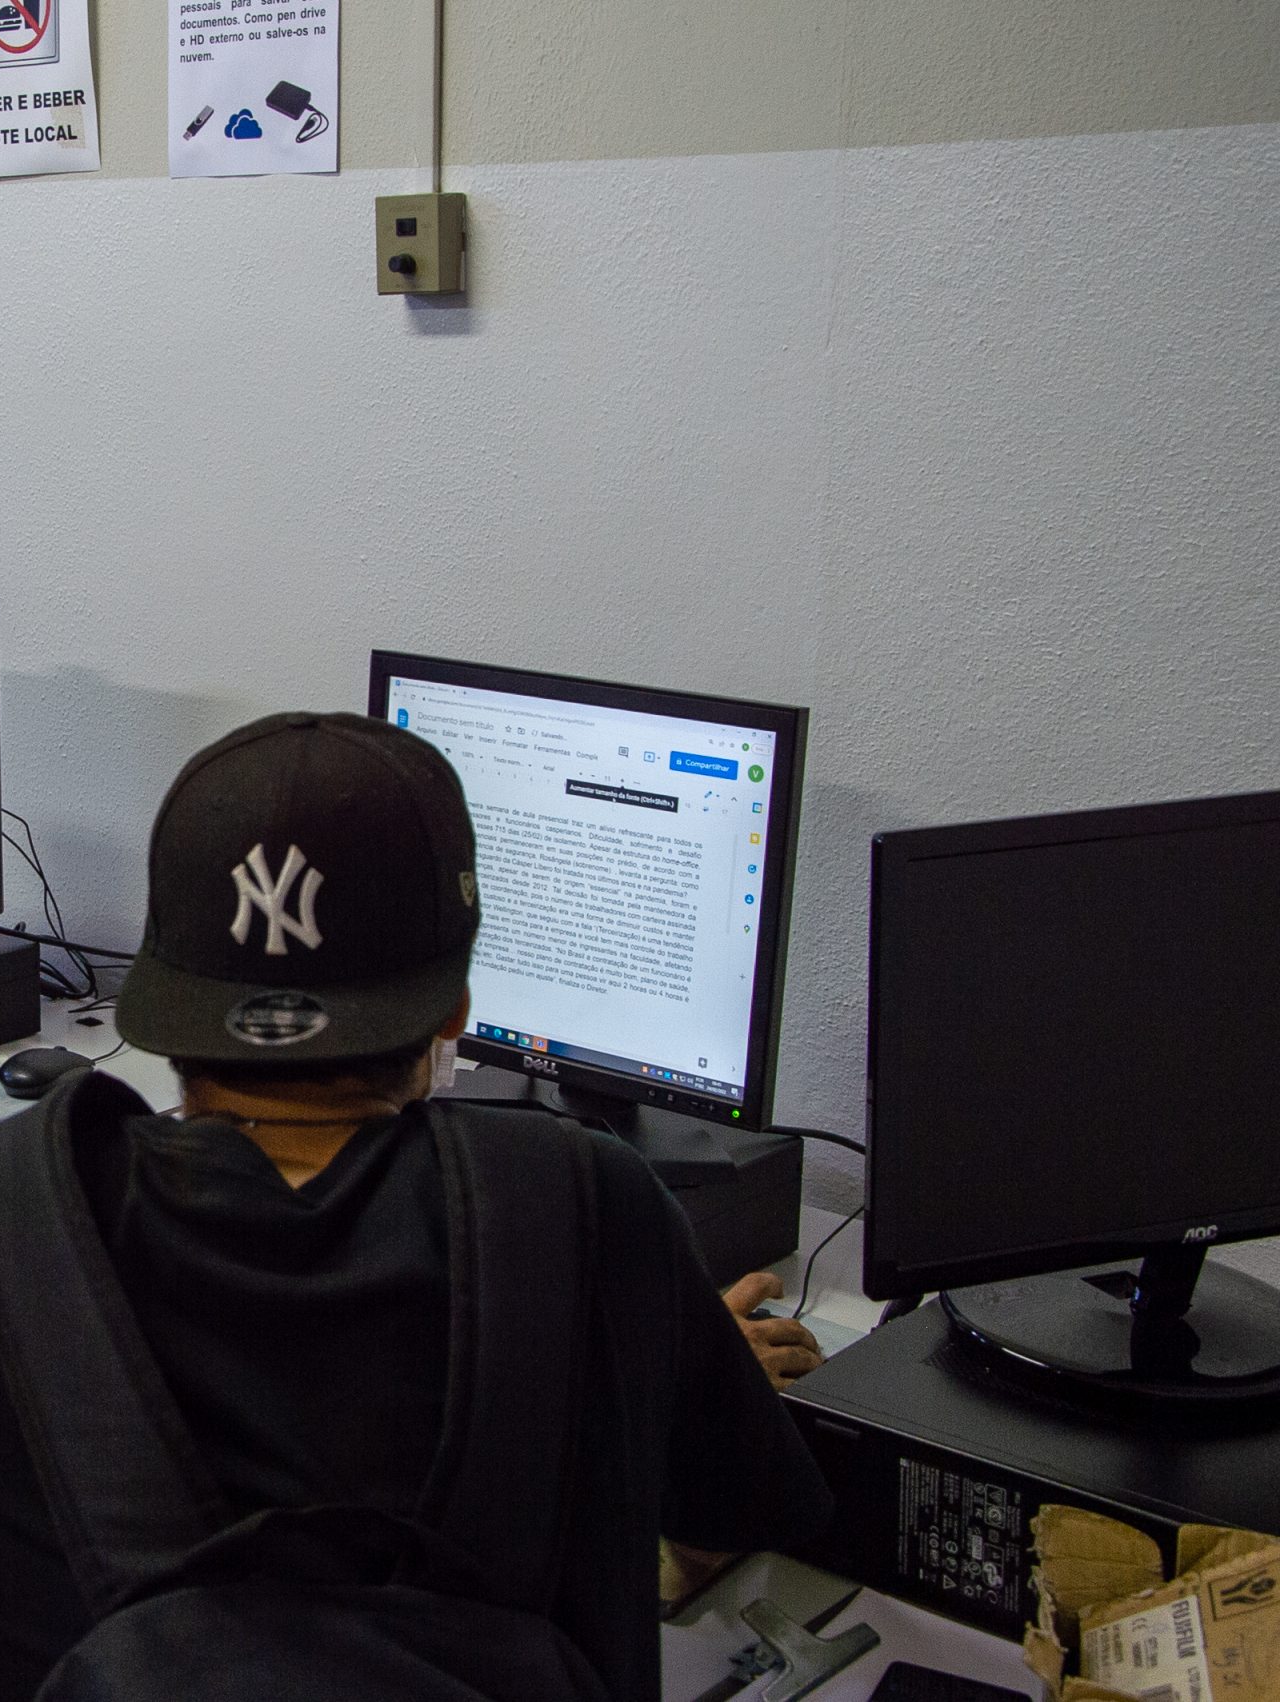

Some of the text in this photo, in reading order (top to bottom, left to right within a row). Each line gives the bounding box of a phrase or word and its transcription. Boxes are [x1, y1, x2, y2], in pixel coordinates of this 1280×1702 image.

[180, 0, 252, 15] pessoais para
[180, 7, 326, 30] documentos. Como pen drive
[180, 25, 326, 47] e HD externo ou salve-os na
[180, 52, 215, 63] nuvem.
[18, 94, 28, 110] E
[33, 89, 87, 109] BEBER
[24, 124, 78, 143] LOCAL
[417, 712, 457, 725] Documento
[442, 729, 458, 738] Editar
[479, 735, 496, 744] Inserir
[502, 739, 527, 749] Formatar
[533, 744, 570, 755] Ferramentas
[685, 758, 729, 773] Compartilhar
[751, 769, 759, 777] V
[229, 843, 325, 956] NY
[523, 1055, 559, 1076] DELL
[1181, 1224, 1218, 1245] AOC
